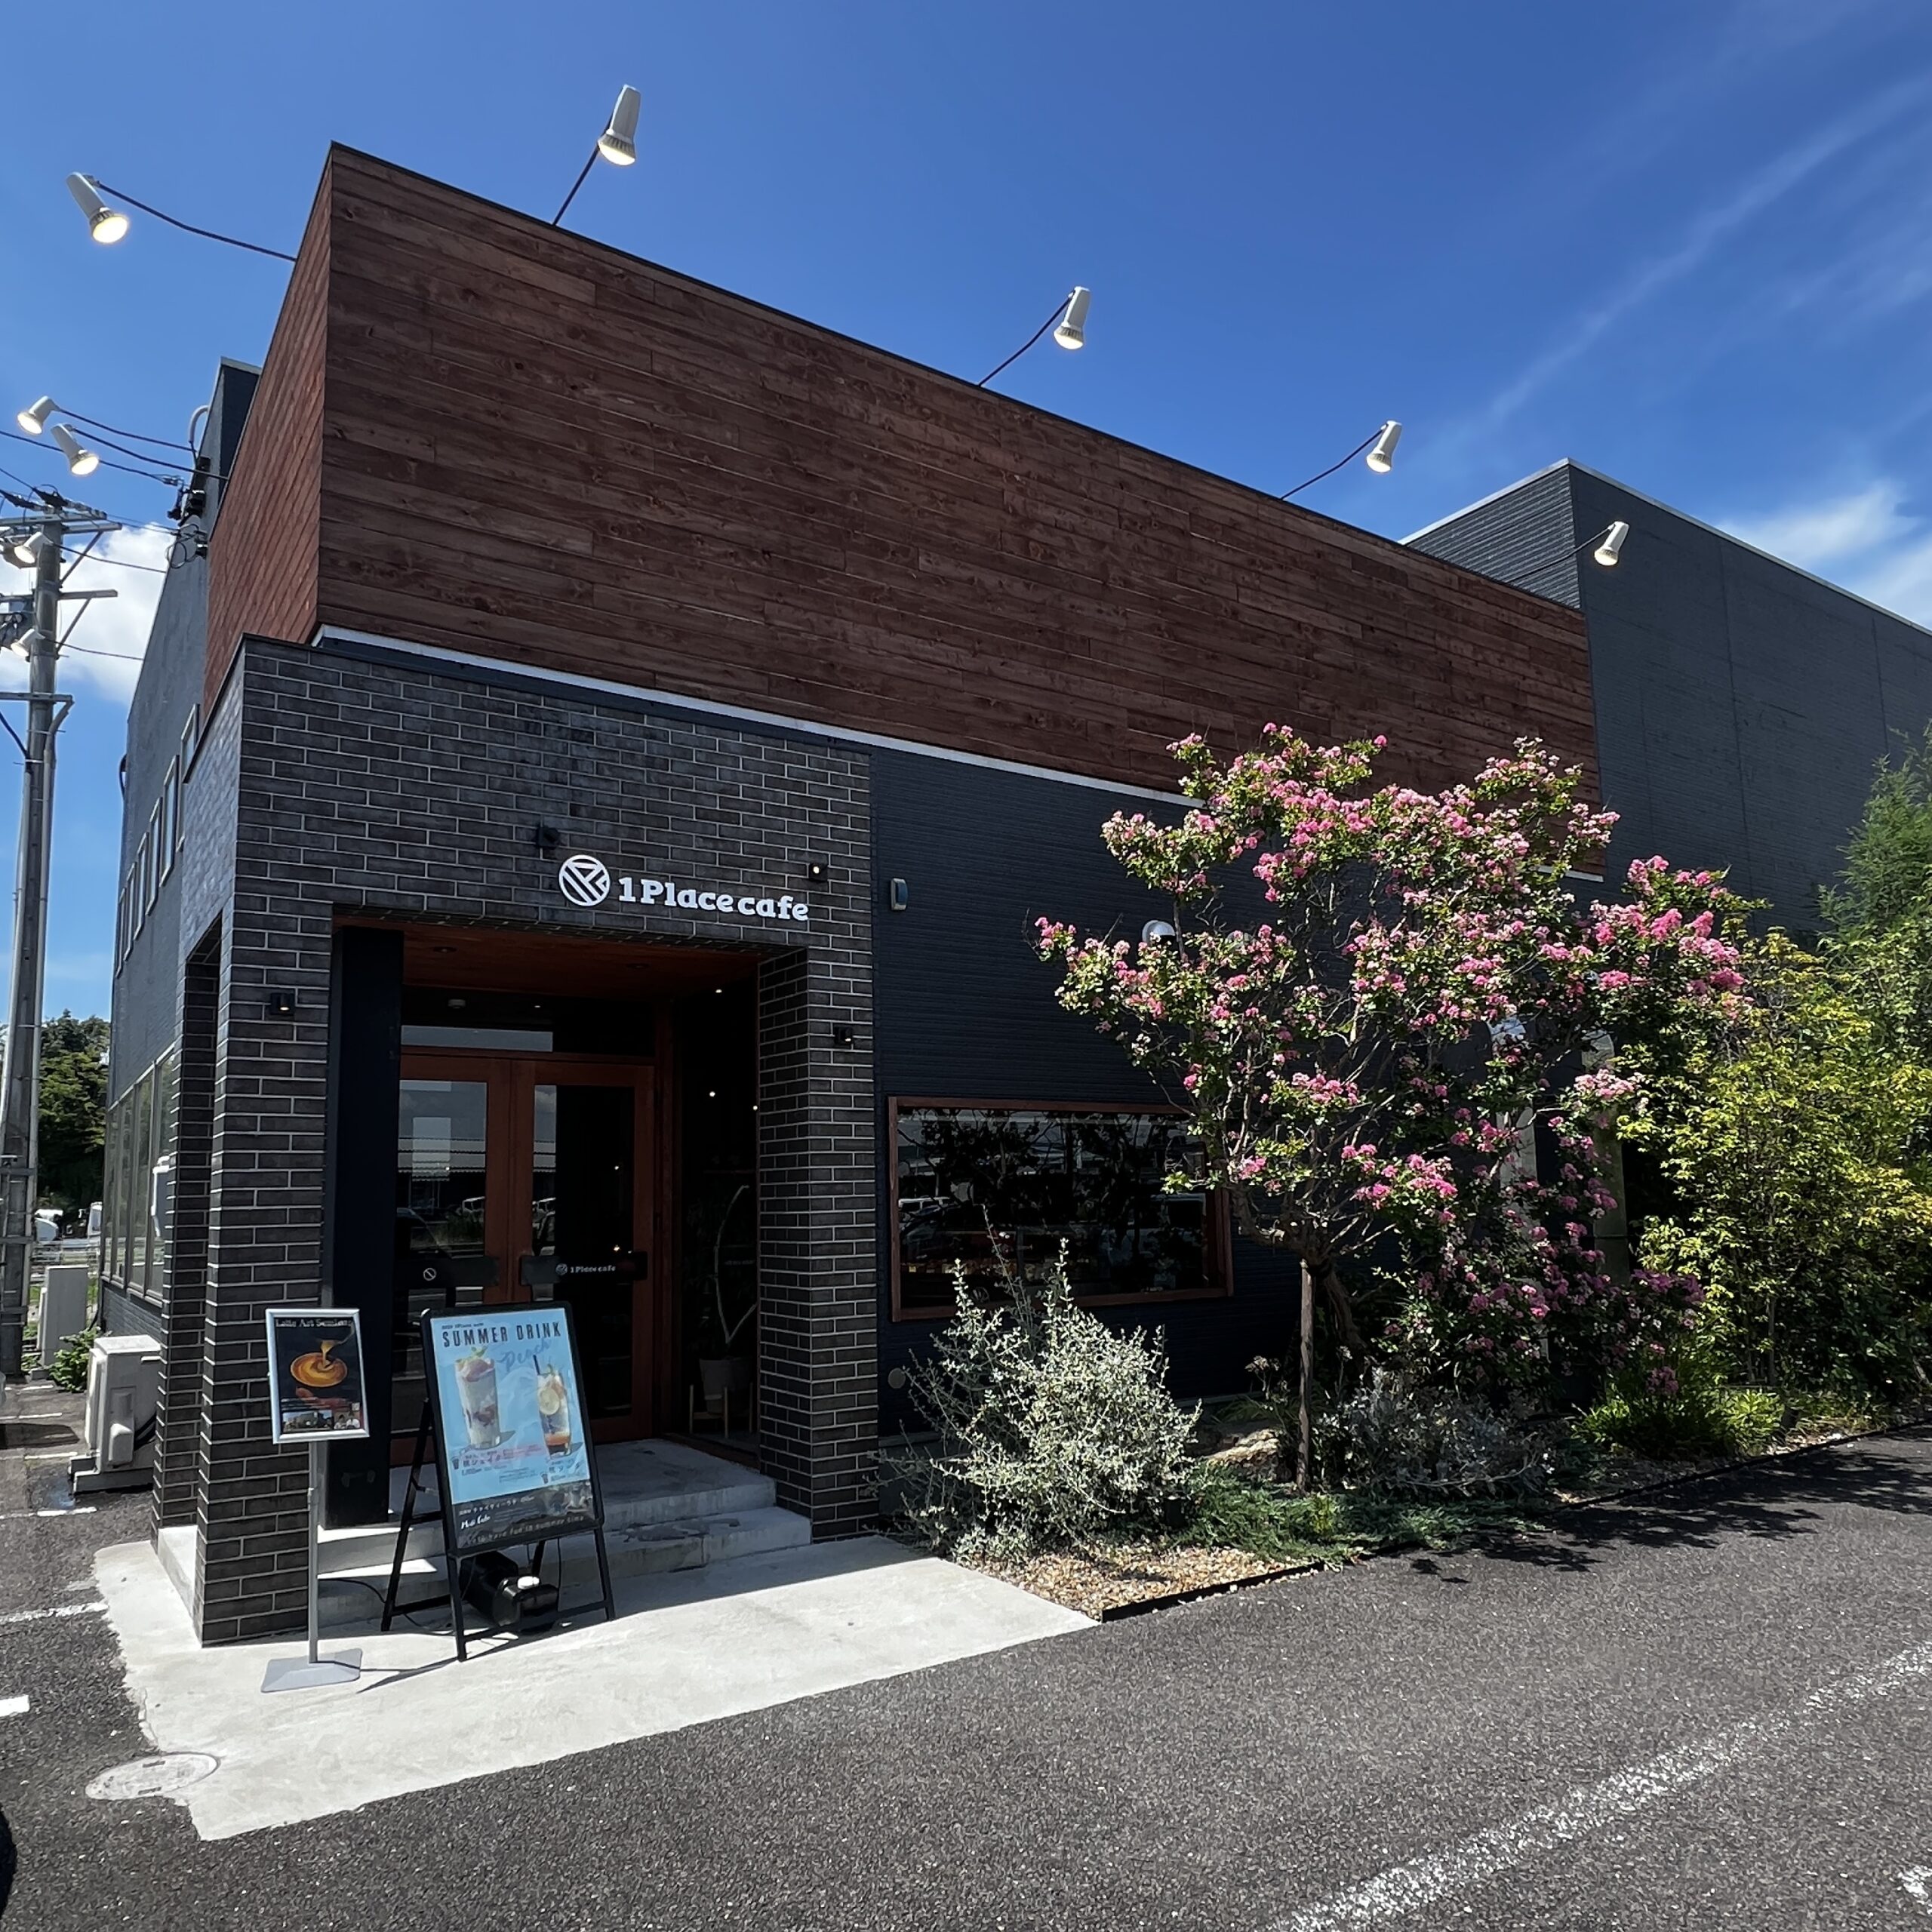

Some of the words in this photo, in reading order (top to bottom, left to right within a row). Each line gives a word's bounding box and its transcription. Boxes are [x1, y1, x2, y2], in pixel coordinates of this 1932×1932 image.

[299, 1318, 315, 1327] Art
[442, 1326, 508, 1348] SUMMER
[516, 1321, 561, 1340] DRINK
[536, 1518, 565, 1530] summer
